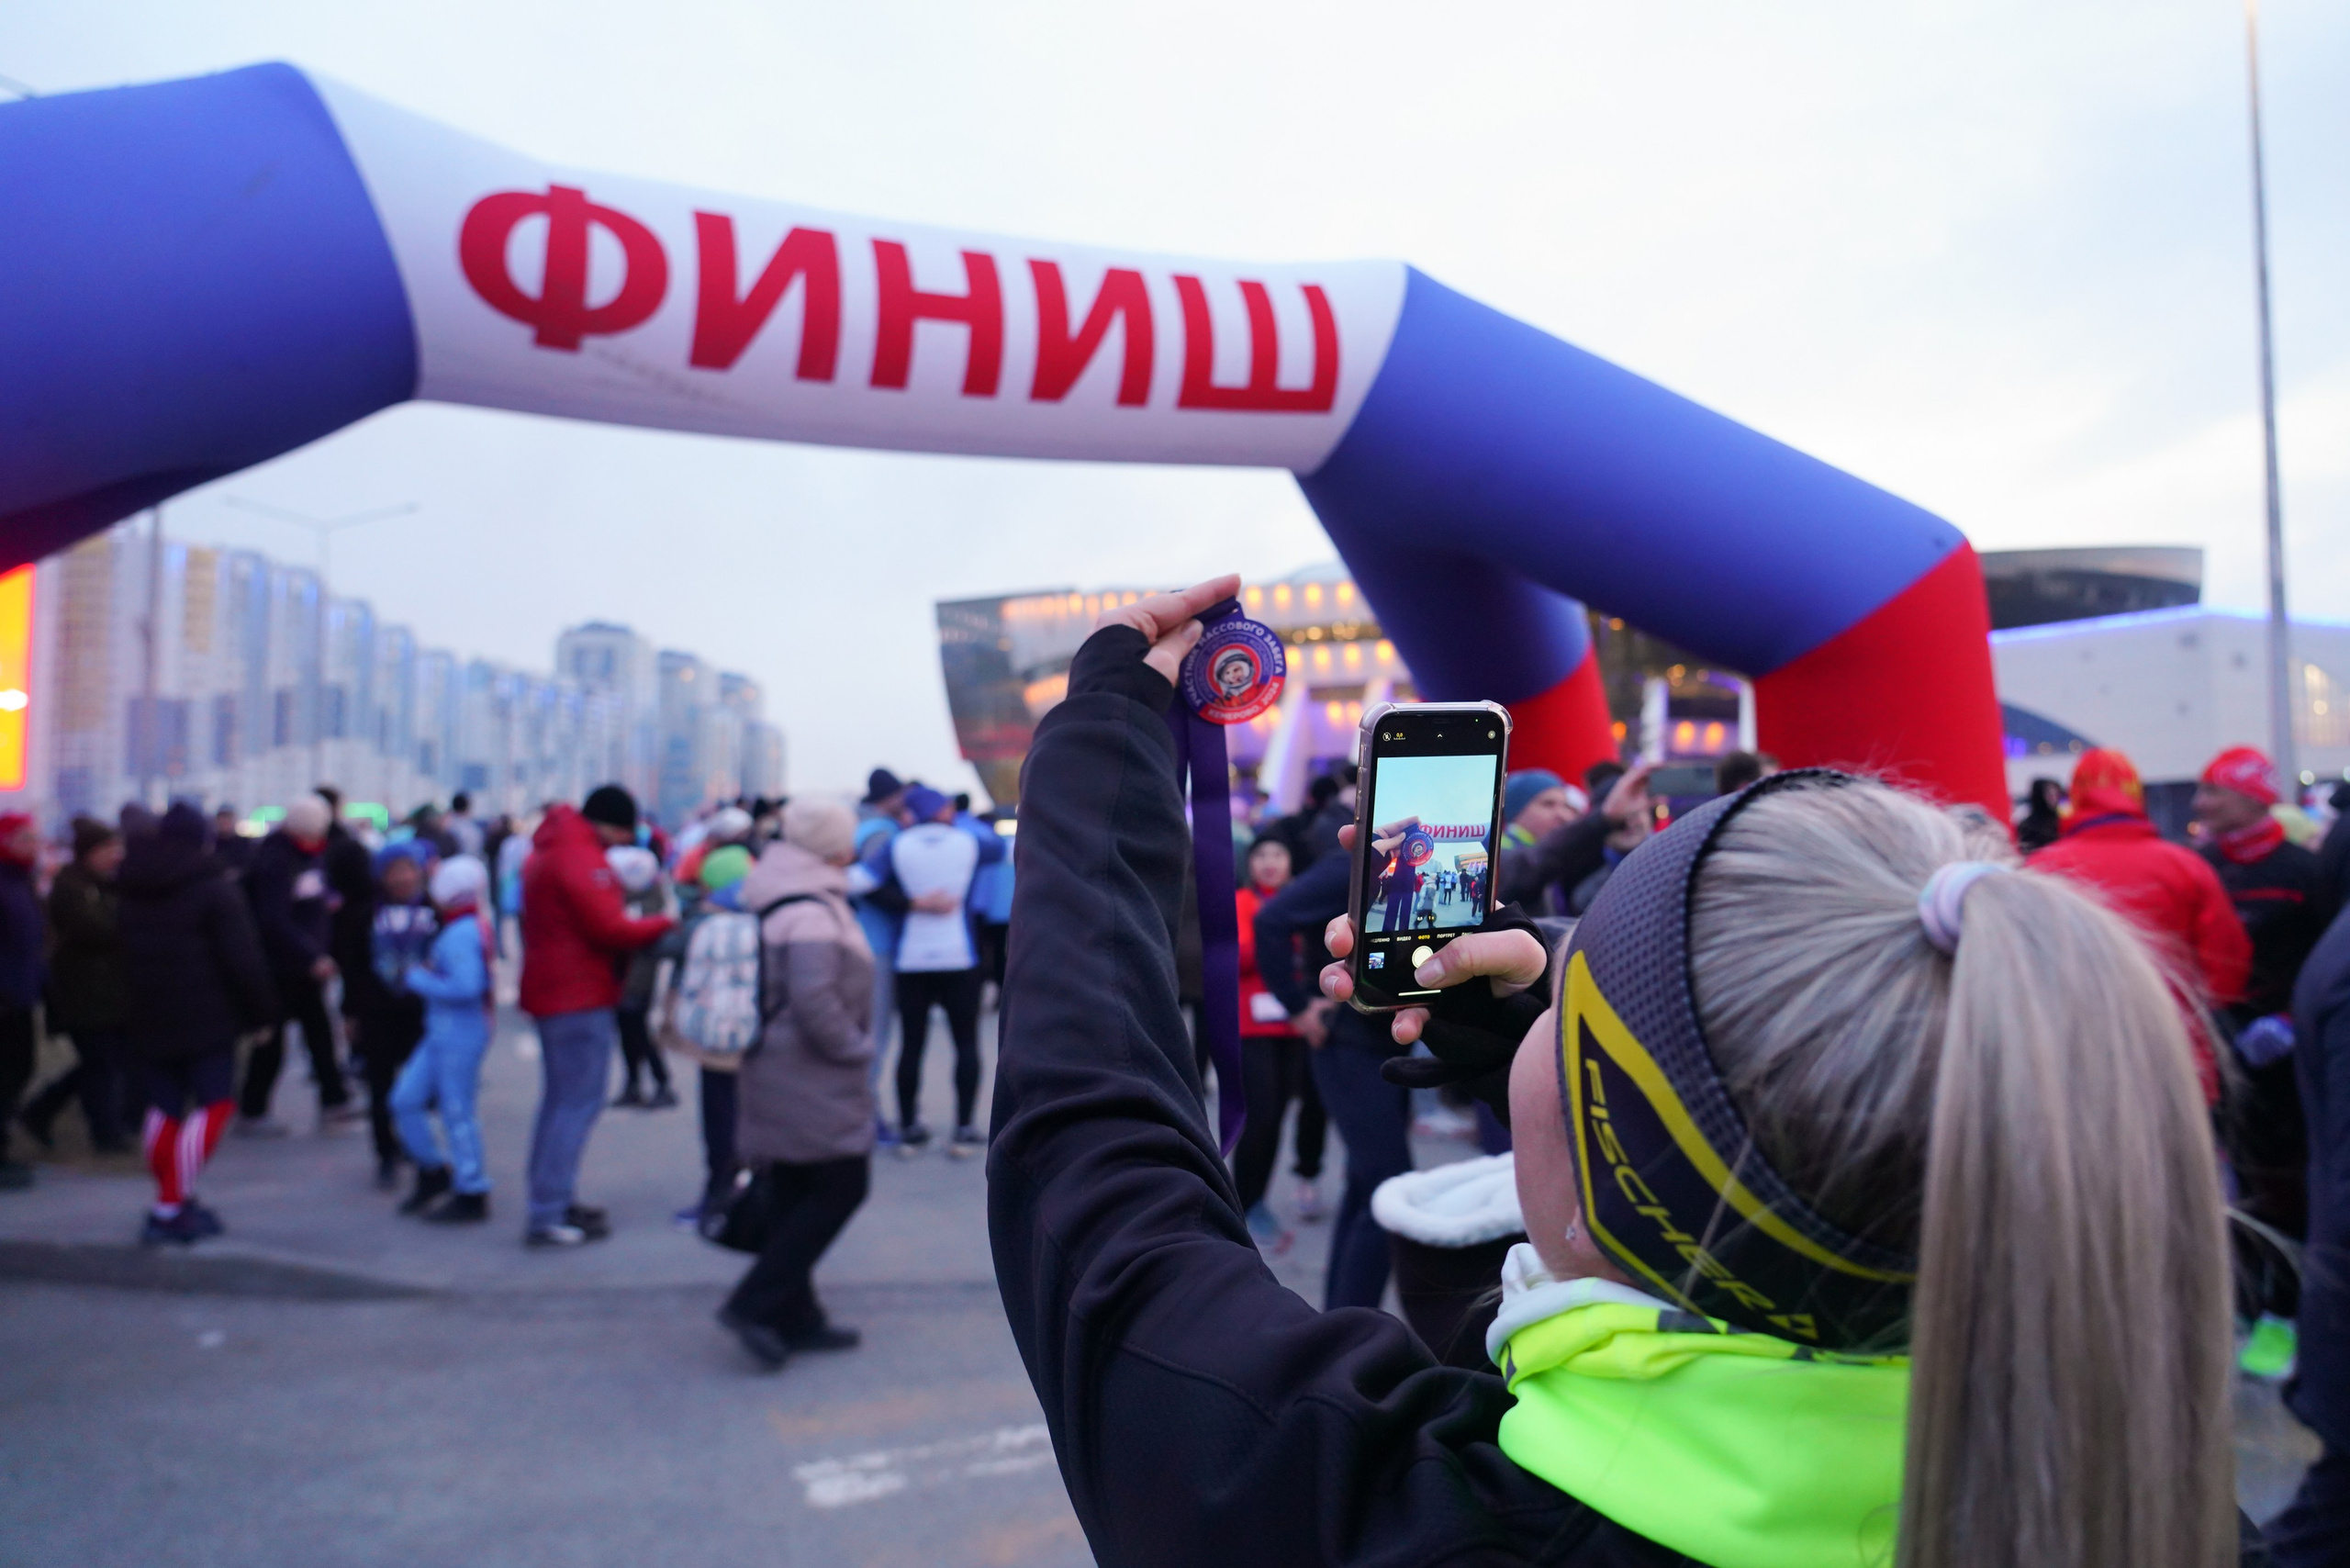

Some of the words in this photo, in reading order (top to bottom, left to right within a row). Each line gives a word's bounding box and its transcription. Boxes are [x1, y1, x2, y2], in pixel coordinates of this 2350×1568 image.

[457, 184, 1341, 414] ФИНИШ
[1184, 647, 1203, 707] УЧАСТНИК
[1264, 633, 1283, 674] ЗАБЕГА
[1420, 824, 1485, 838] ФИНИШ
[1585, 1058, 1776, 1310] FISCHER
